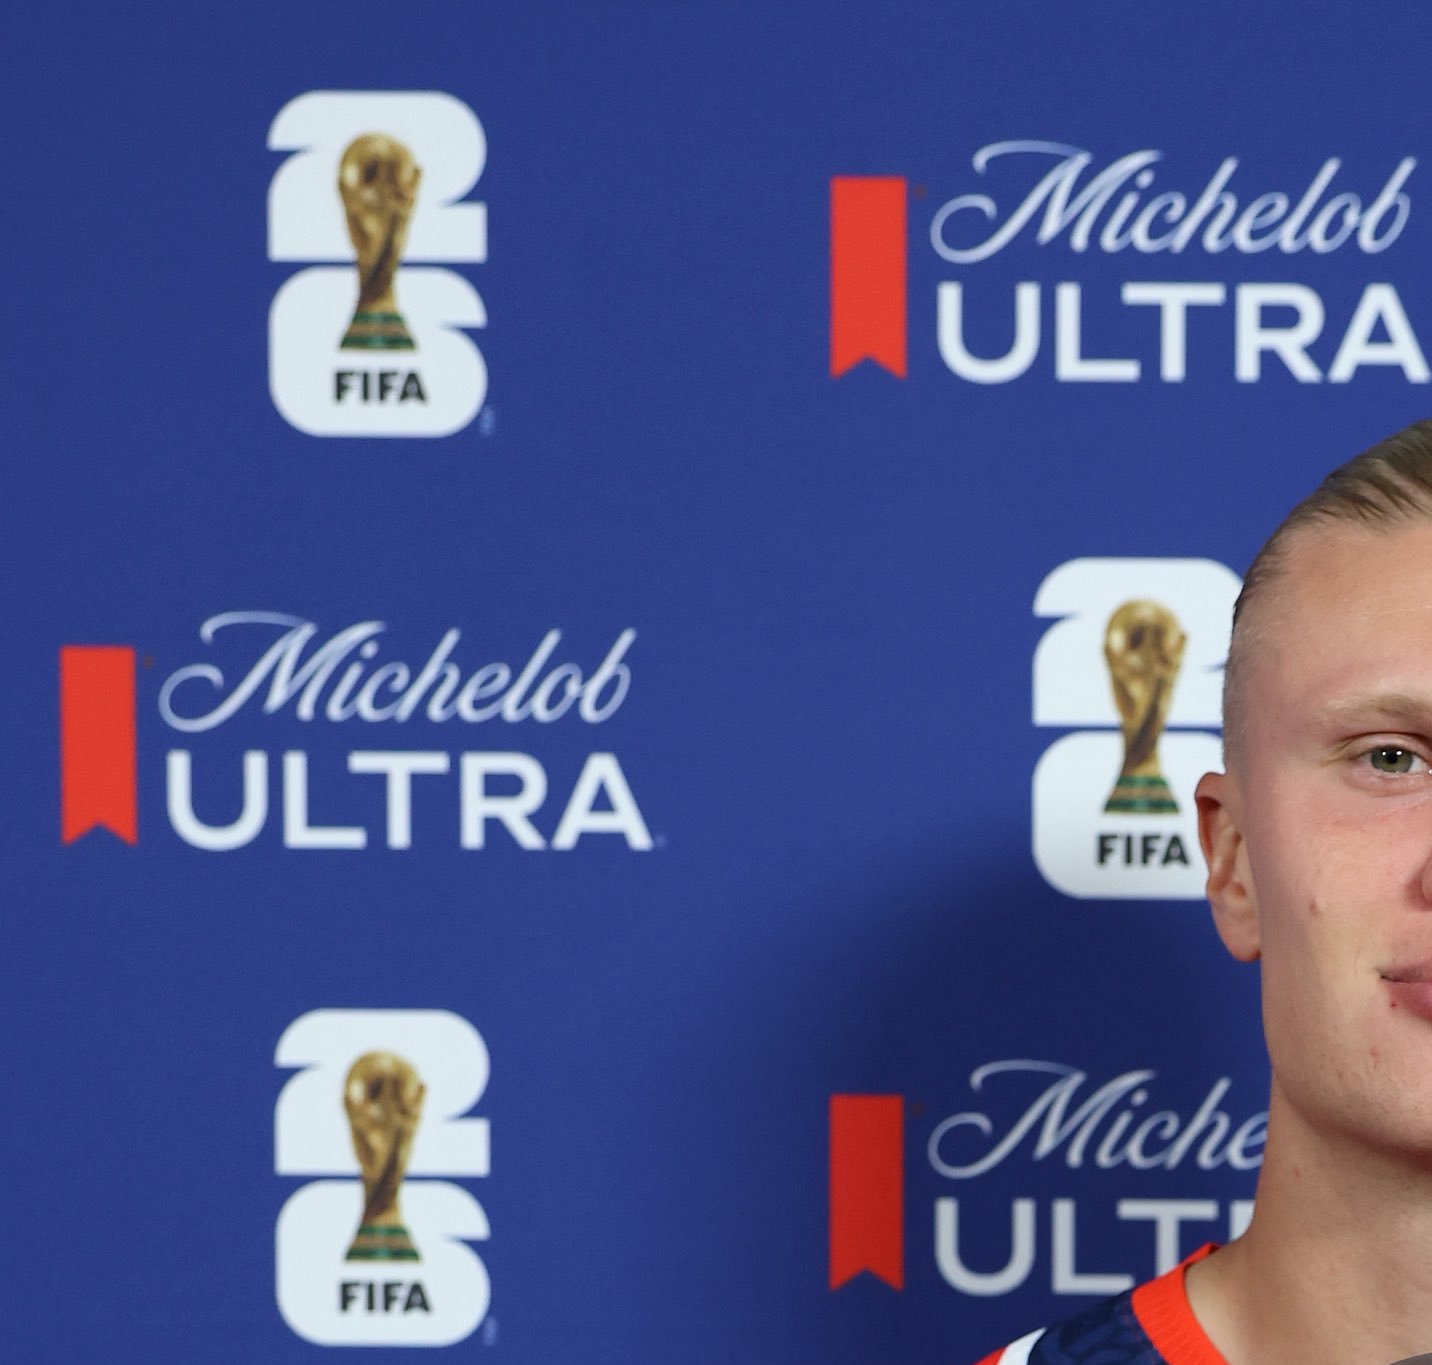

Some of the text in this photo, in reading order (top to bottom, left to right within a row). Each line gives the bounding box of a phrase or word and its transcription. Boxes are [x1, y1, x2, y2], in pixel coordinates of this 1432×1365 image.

[930, 141, 1416, 263] Michelob
[937, 282, 1431, 384] ULTRA
[333, 370, 427, 403] FIFA
[159, 612, 636, 732] Michelob
[167, 750, 652, 851] ULTRA
[1096, 833, 1190, 867] FIFA
[339, 1280, 431, 1314] FIFA
